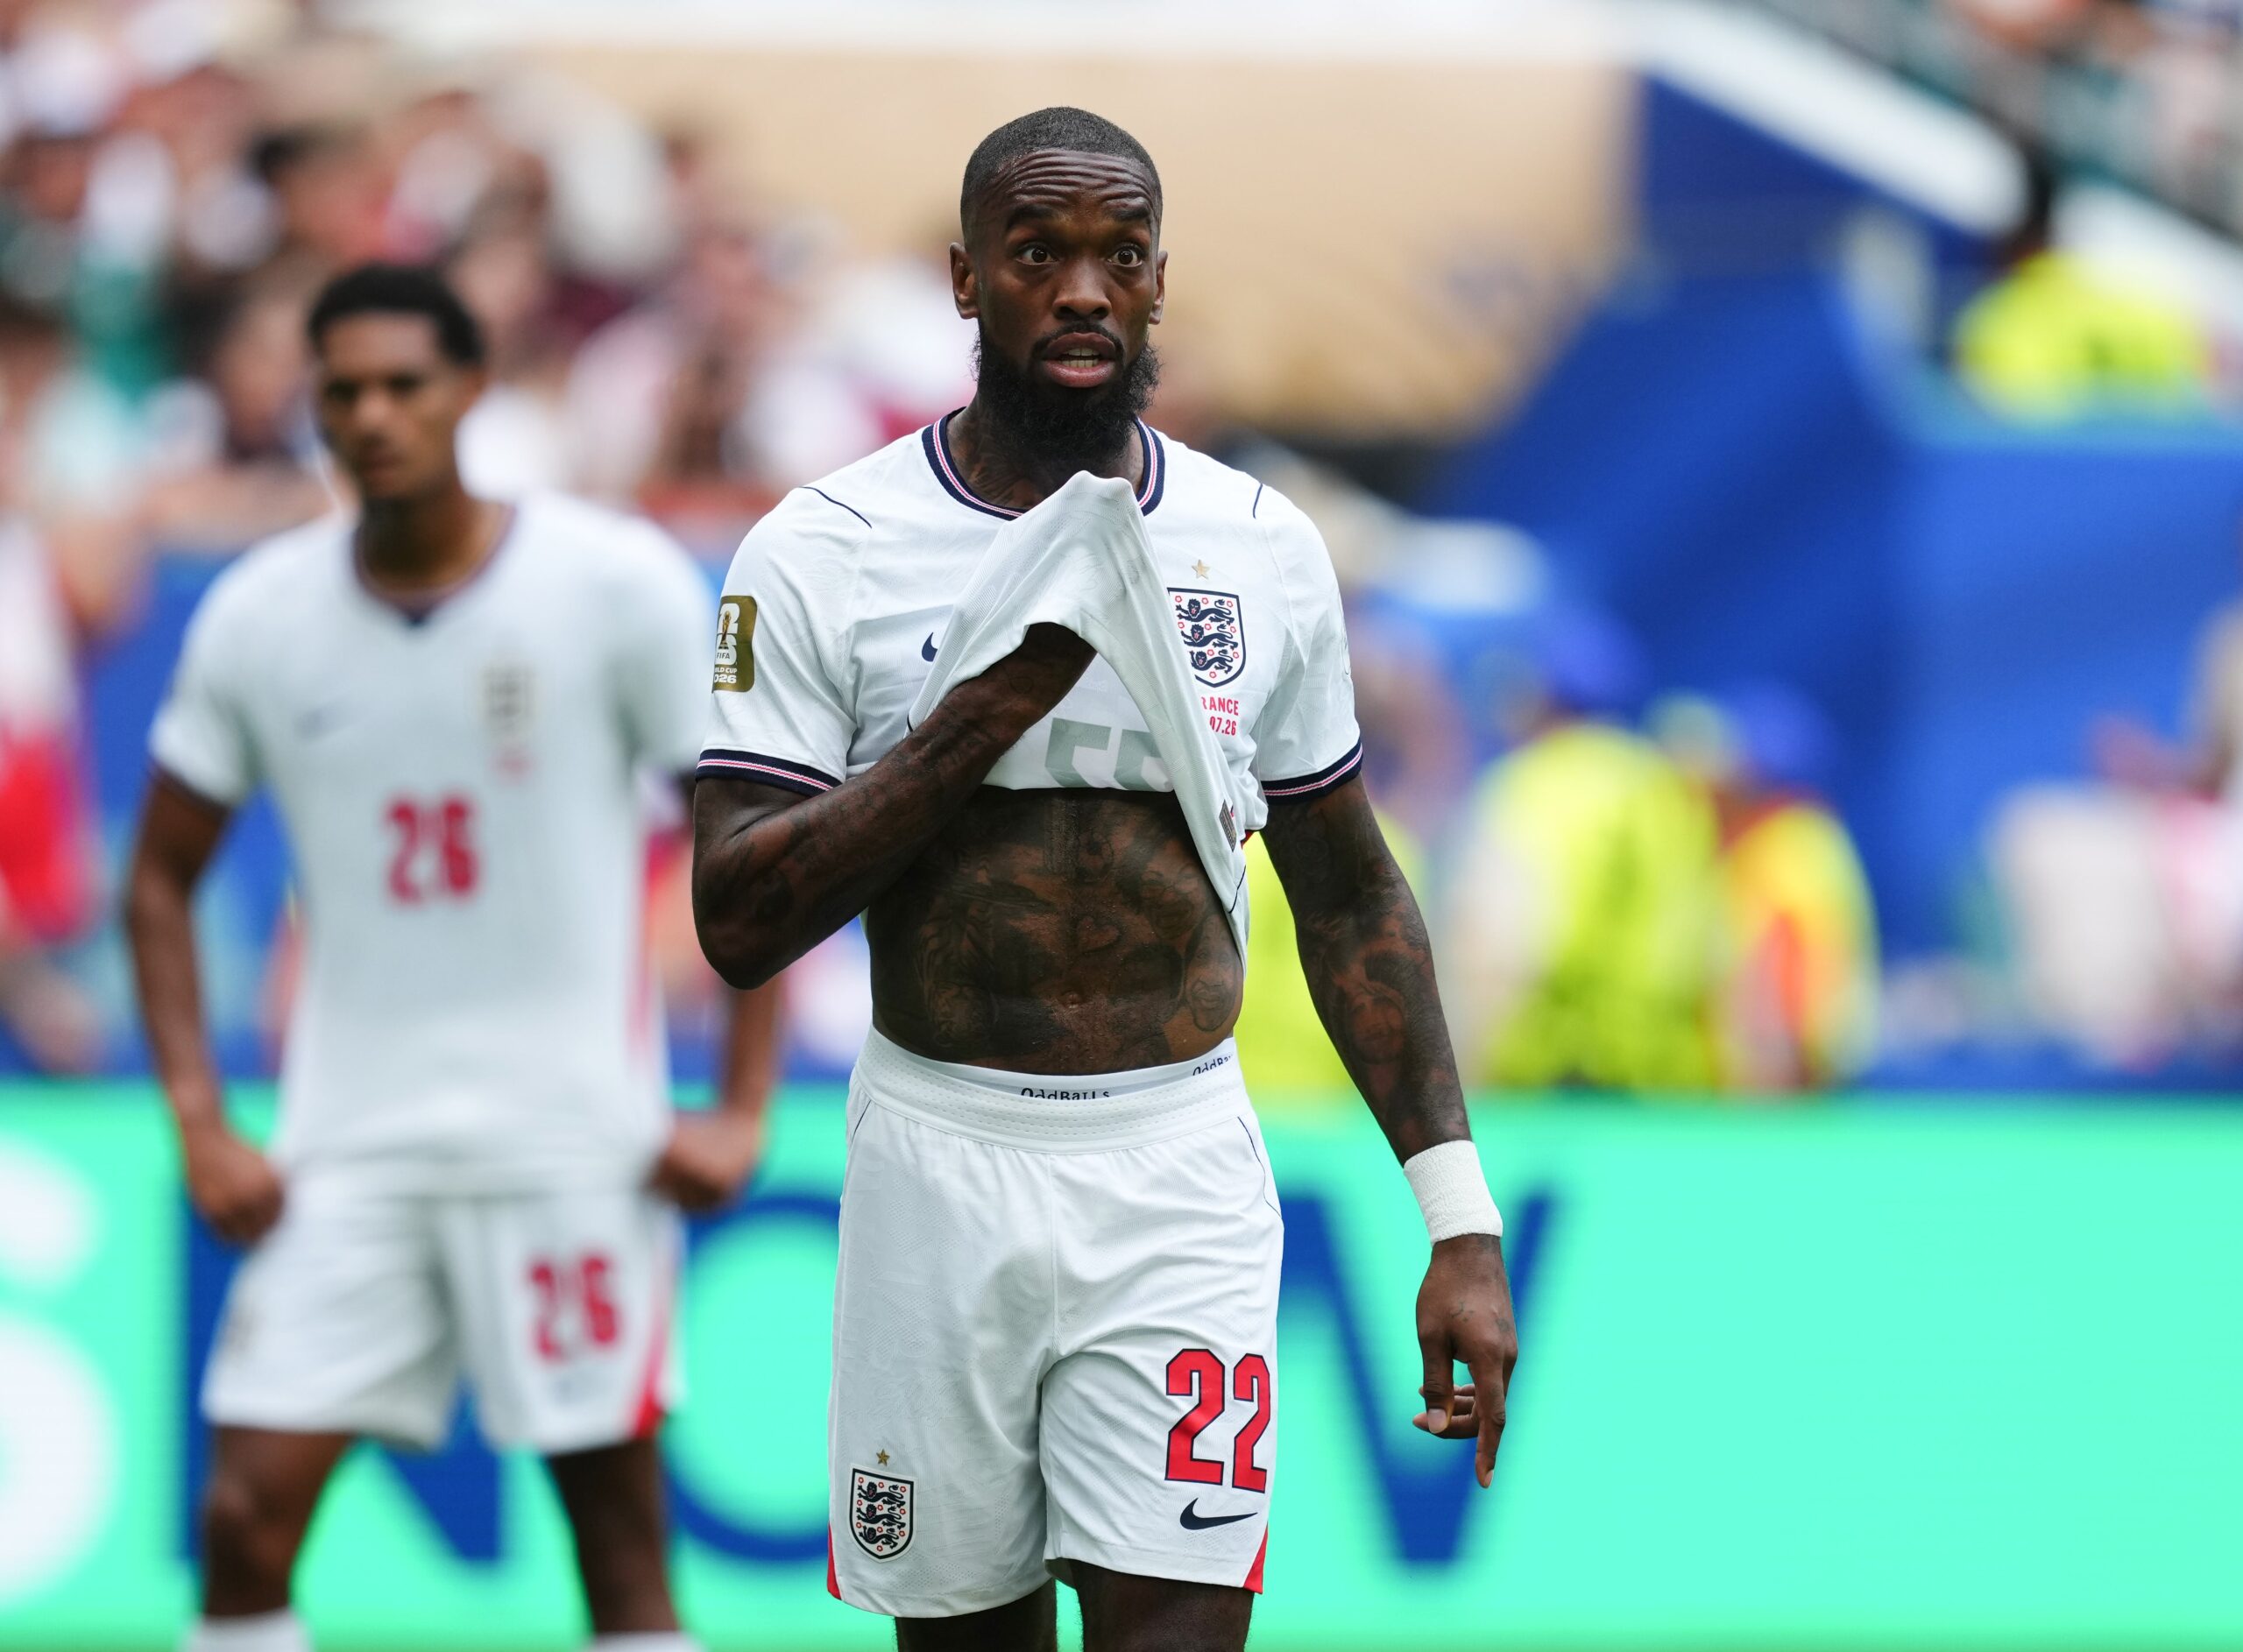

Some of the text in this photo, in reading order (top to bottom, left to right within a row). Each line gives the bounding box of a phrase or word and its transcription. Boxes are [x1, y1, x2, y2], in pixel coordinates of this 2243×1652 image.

[386, 793, 479, 907] 26
[527, 1252, 619, 1364] 26
[1164, 1348, 1270, 1494] 22
